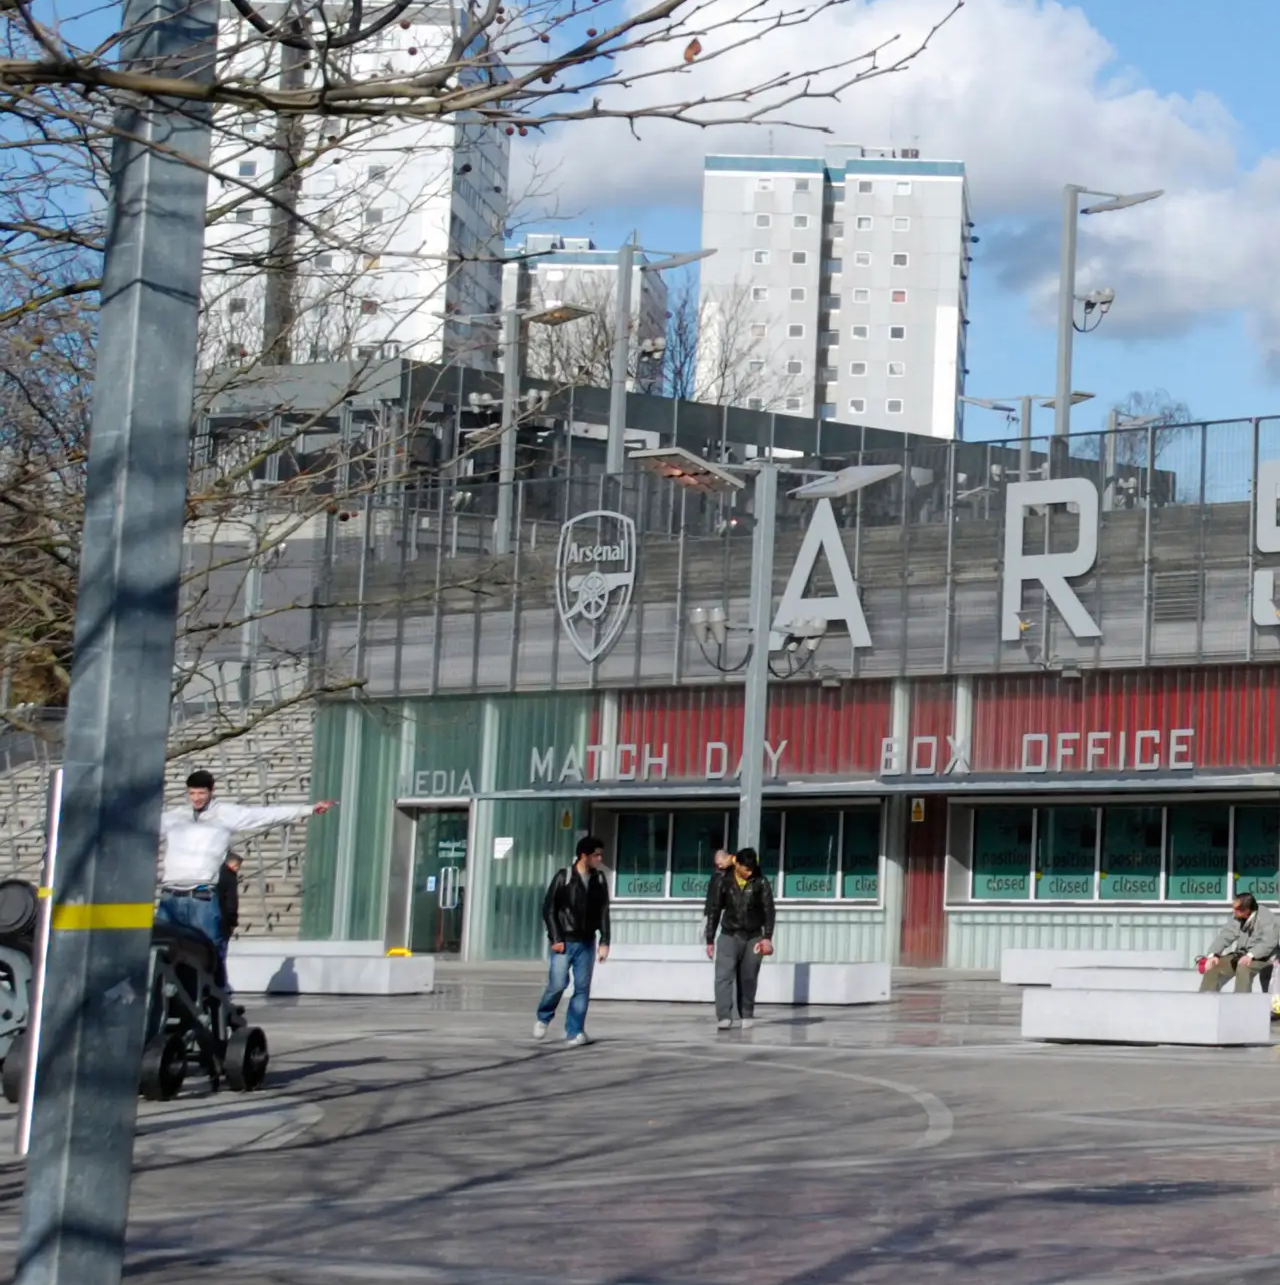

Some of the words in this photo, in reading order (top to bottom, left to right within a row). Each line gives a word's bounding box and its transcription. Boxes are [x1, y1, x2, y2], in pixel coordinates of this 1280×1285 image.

[567, 539, 626, 564] Arsenal
[530, 742, 669, 784] MATCH
[706, 739, 788, 781] DY
[881, 735, 971, 776] BOX
[1022, 728, 1195, 774] OFFICE
[627, 877, 662, 893] closed
[795, 876, 832, 893] closed
[986, 873, 1026, 894] closed
[1049, 876, 1089, 895] closed
[1112, 875, 1157, 894] closed
[1179, 876, 1222, 895] closed
